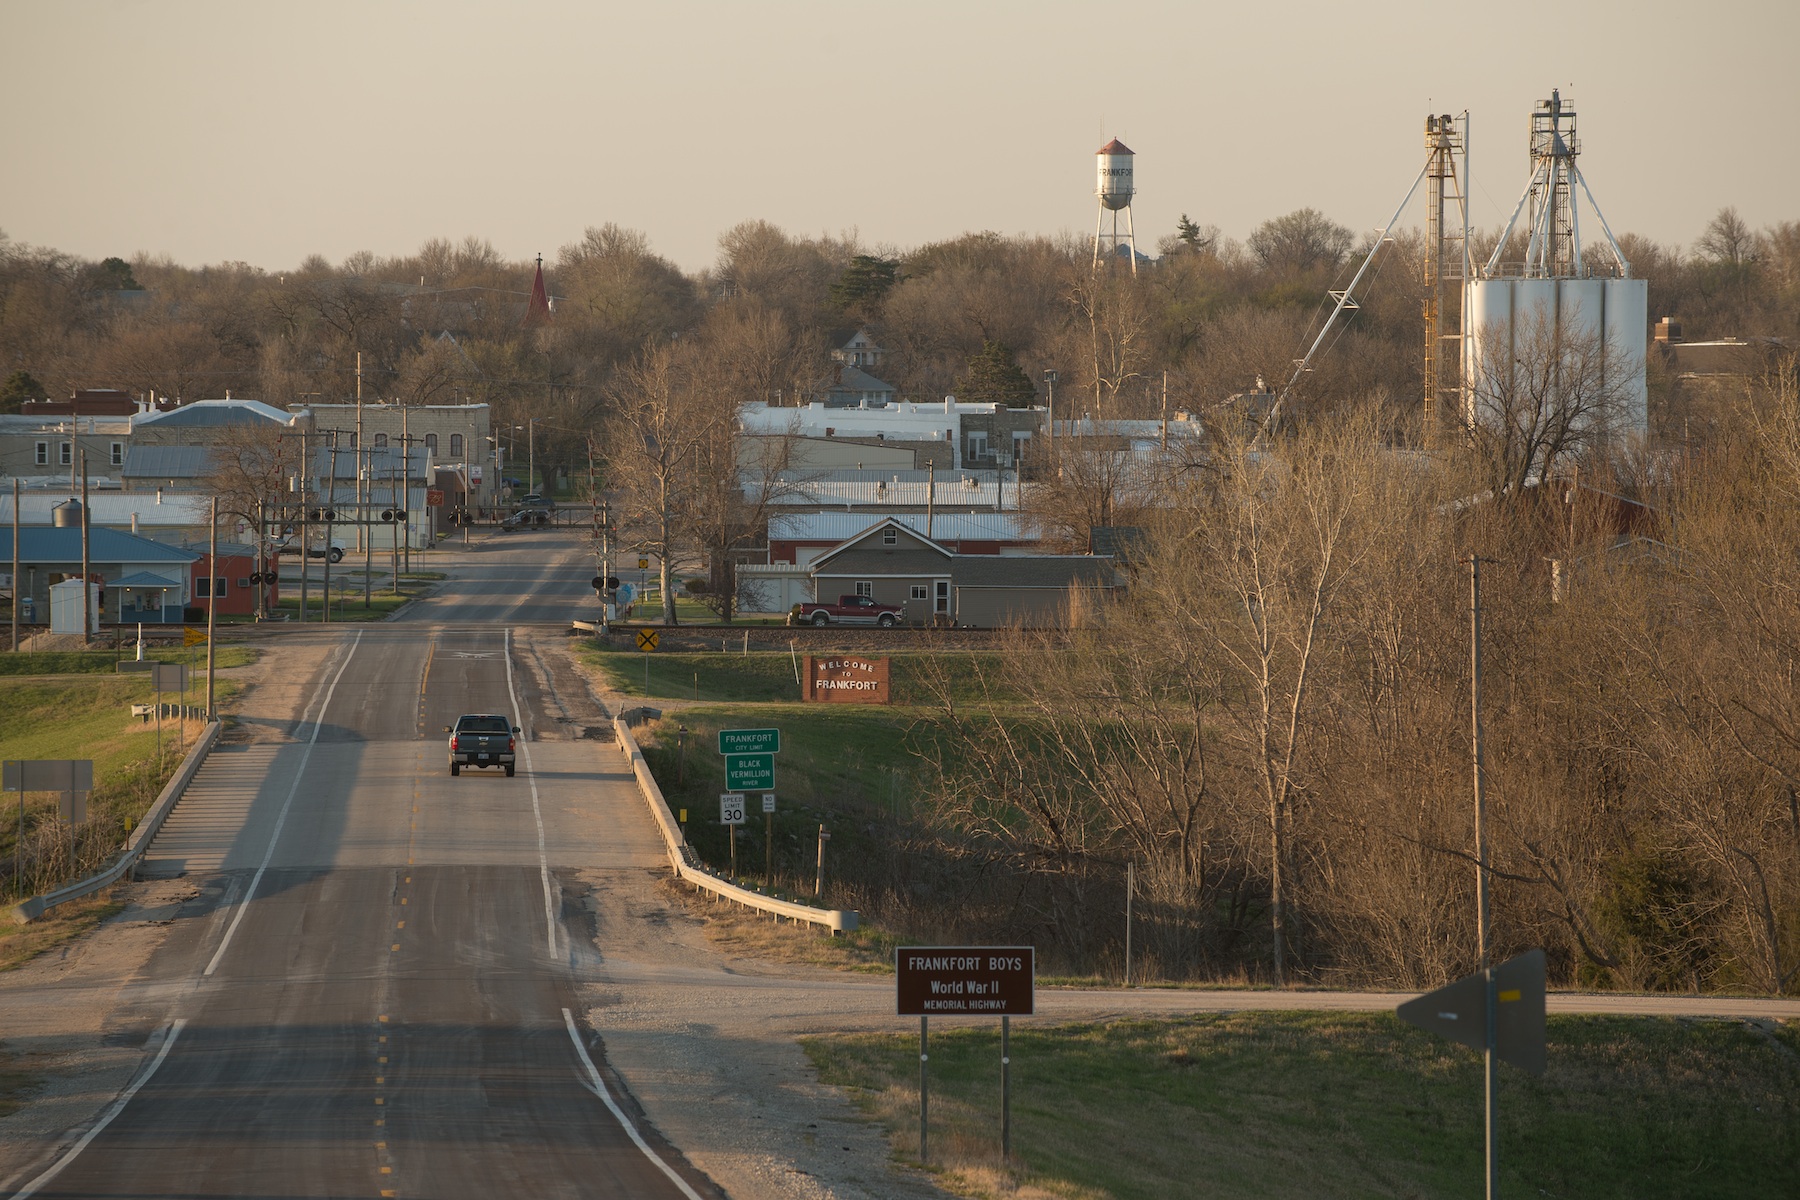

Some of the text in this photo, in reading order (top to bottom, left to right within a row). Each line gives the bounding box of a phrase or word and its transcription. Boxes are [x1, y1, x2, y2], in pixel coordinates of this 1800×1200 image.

[819, 660, 874, 672] WELCOME
[816, 680, 878, 690] FRANKFORT
[725, 733, 773, 743] FRANKFORT
[738, 760, 761, 768] BLACK
[730, 769, 771, 779] VERMILLION
[724, 809, 742, 821] 30
[908, 957, 1022, 971] FRANKFORT BOYS
[930, 980, 999, 994] World War II
[923, 1000, 1007, 1009] MEMORIAL HIGHWAY
